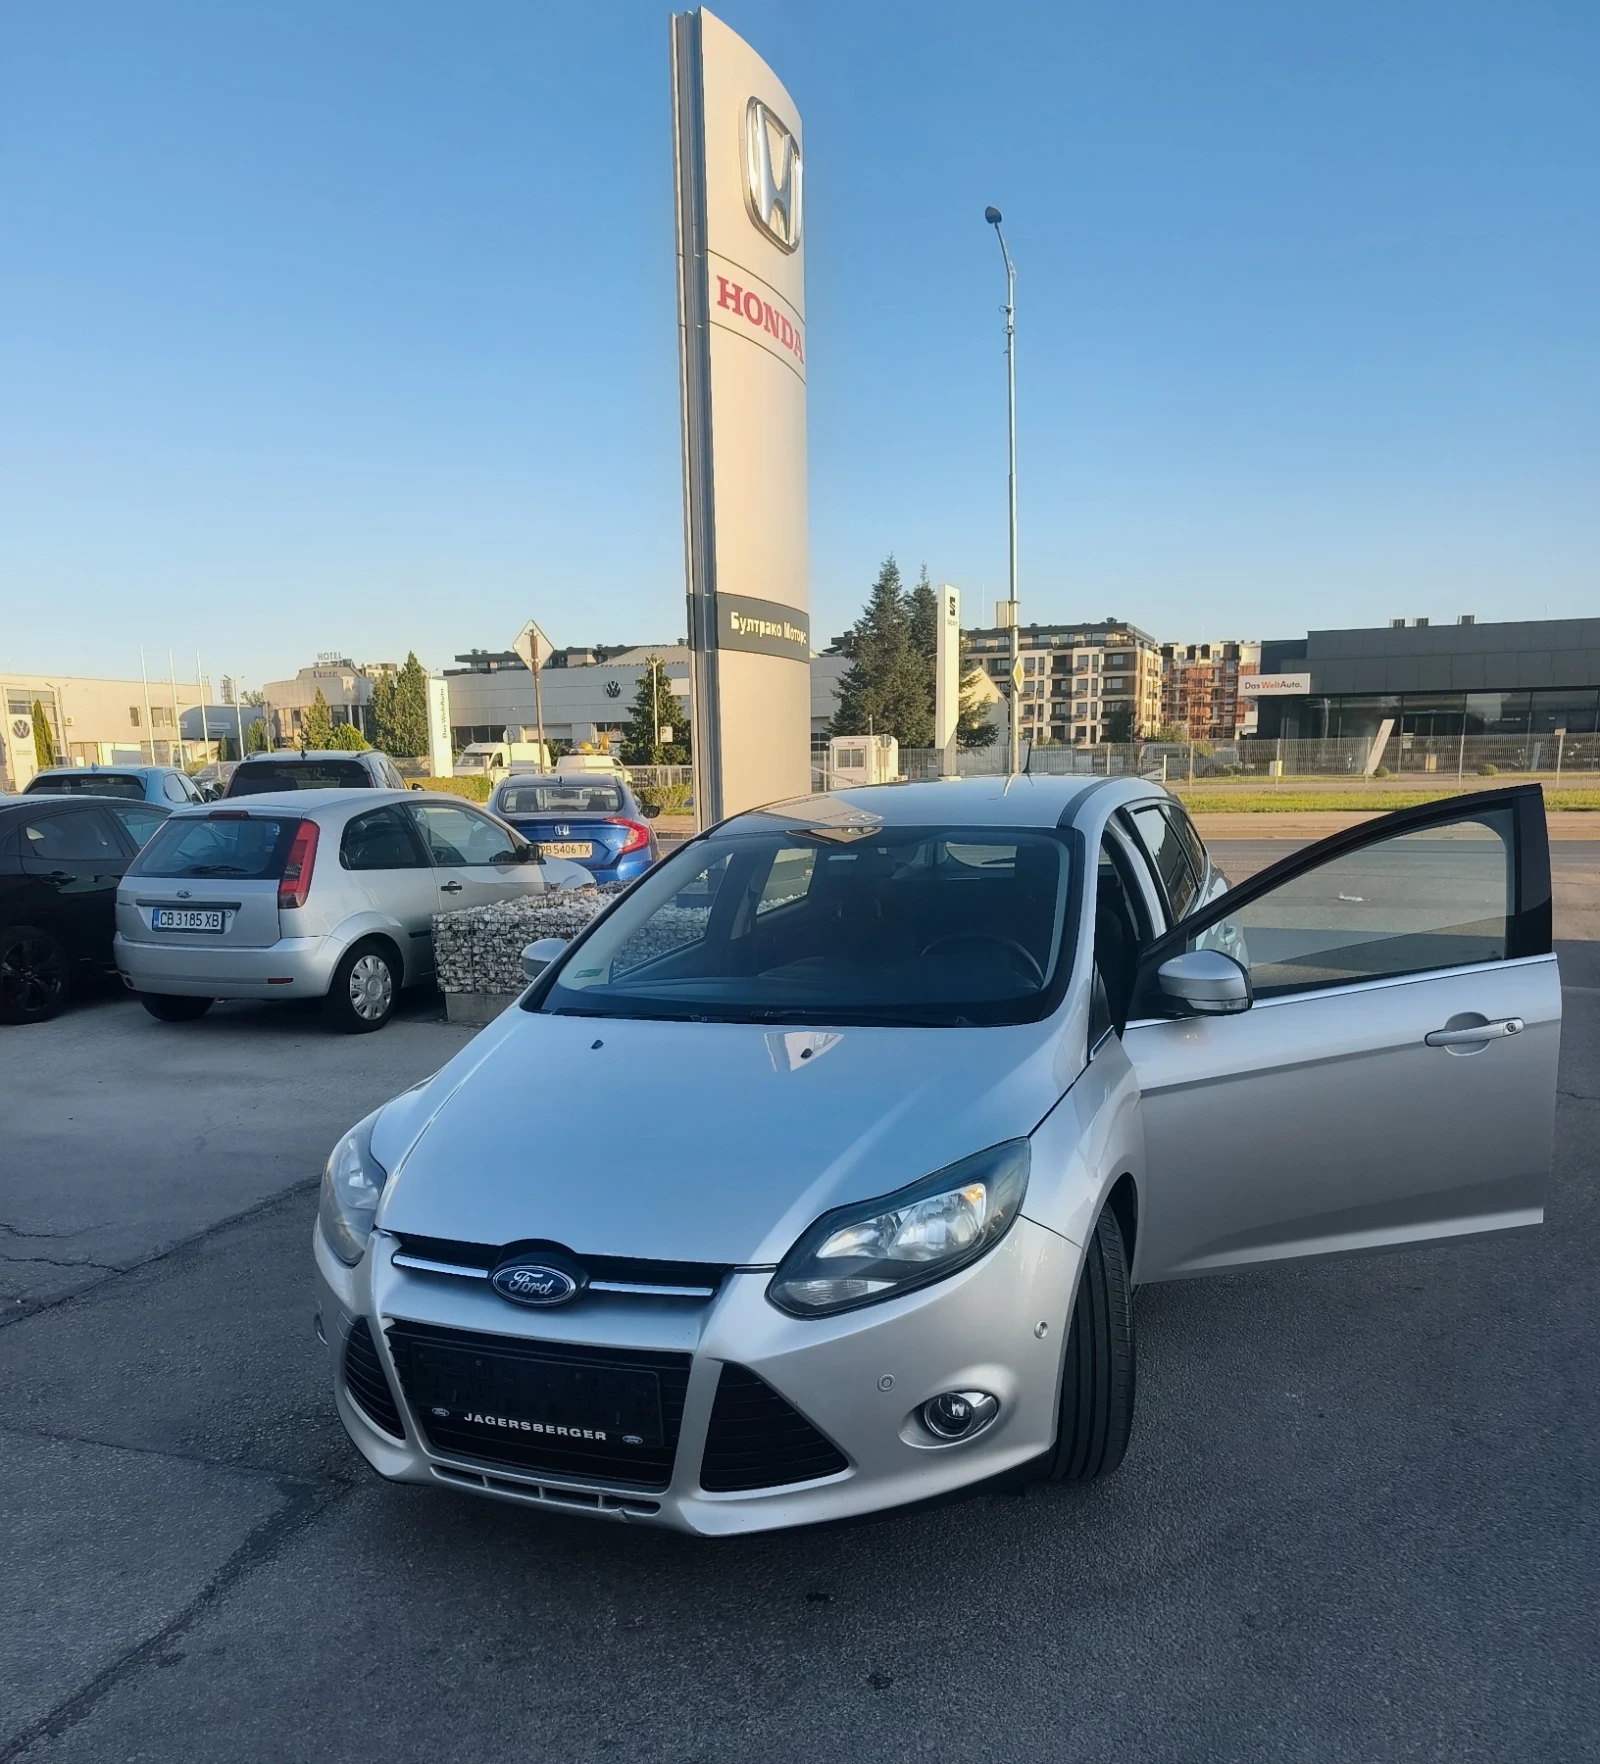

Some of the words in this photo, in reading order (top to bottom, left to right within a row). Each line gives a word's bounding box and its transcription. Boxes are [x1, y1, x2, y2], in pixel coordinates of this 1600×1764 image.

[716, 275, 804, 364] HONDA
[730, 611, 782, 638] Бултрако
[317, 651, 343, 661] HOTEL
[1244, 681, 1260, 690] Das
[553, 845, 577, 855] 5406
[578, 844, 591, 854] TX
[160, 911, 174, 926] CB
[175, 912, 203, 927] 3185
[204, 913, 220, 928] XB
[508, 1270, 555, 1296] Ford
[463, 1412, 608, 1442] JAGERSBERGER
